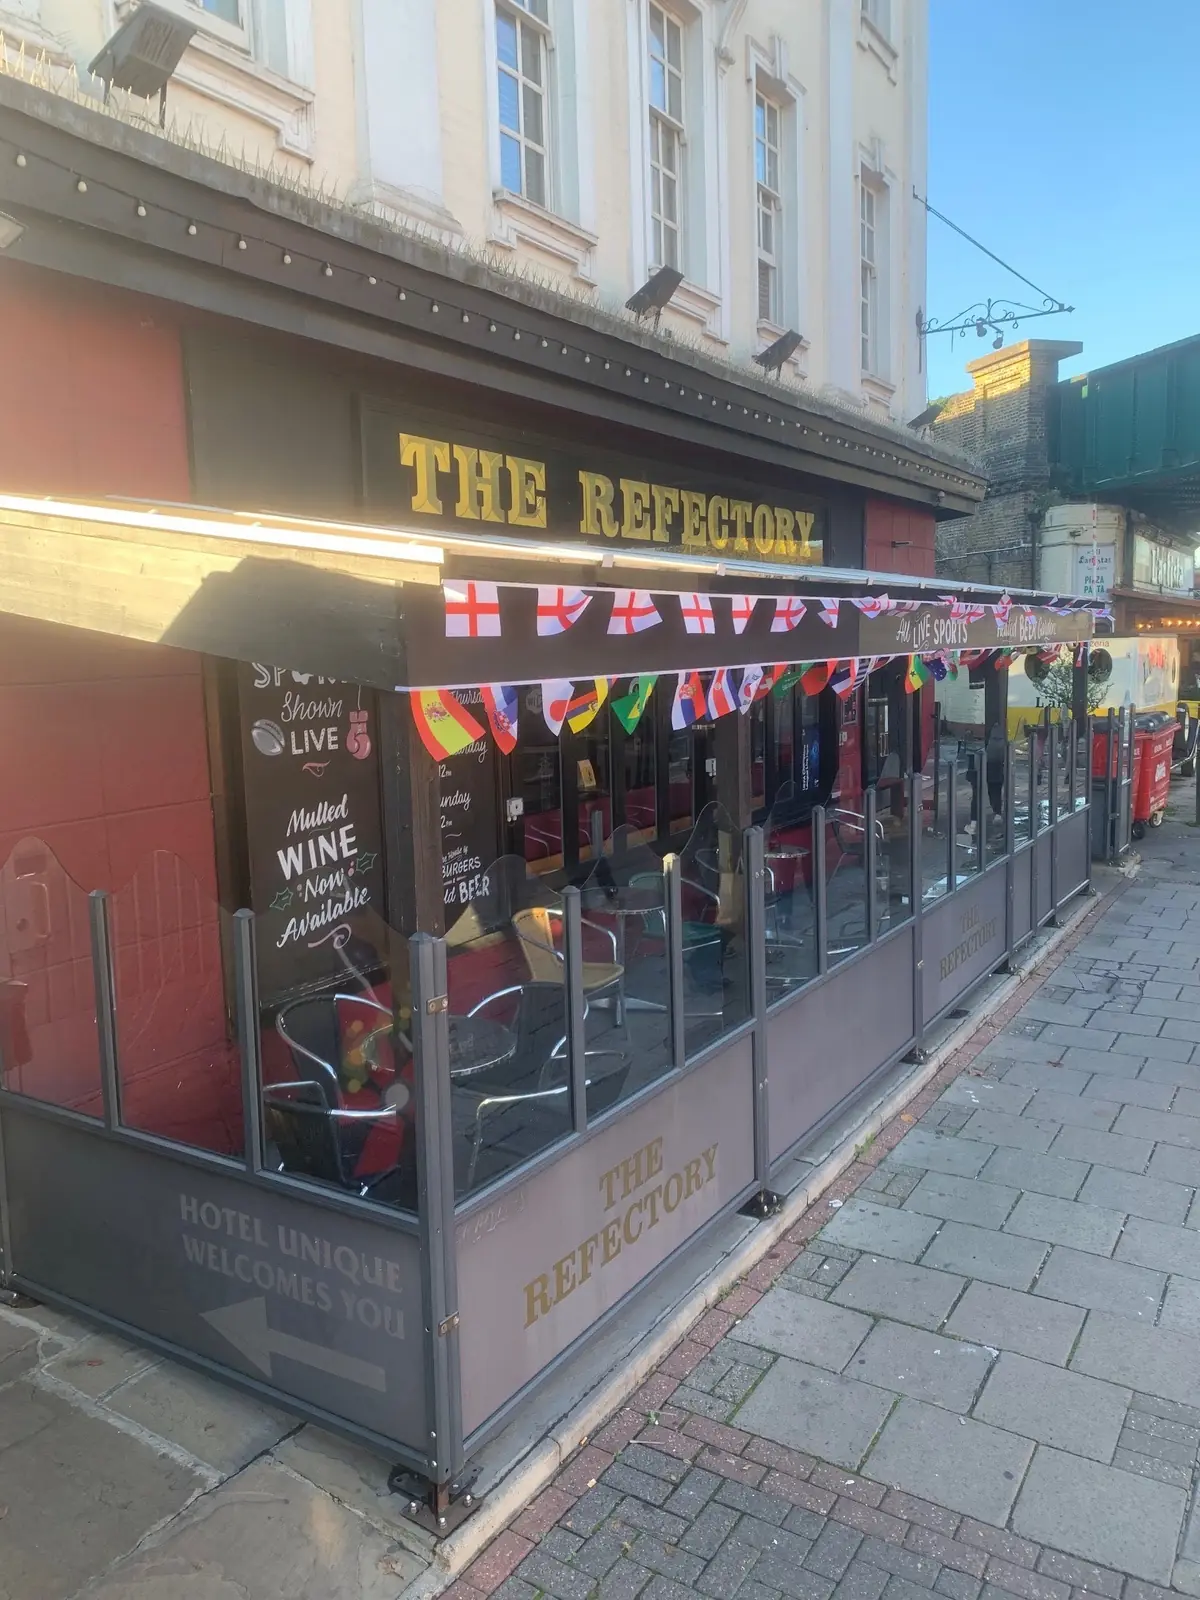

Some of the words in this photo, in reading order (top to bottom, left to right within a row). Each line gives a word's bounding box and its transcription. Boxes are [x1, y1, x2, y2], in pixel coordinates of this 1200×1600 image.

[399, 432, 547, 528] THE
[579, 470, 816, 558] REFECTORY
[1083, 586, 1105, 594] PATA
[913, 614, 931, 649] LIVE
[933, 619, 968, 645] SPORTS
[281, 691, 343, 722] Shown
[290, 727, 339, 755] LIVE
[286, 794, 349, 836] Mulled
[440, 790, 471, 810] unday
[277, 824, 358, 880] WINE
[304, 868, 345, 902] Now
[443, 886, 457, 904] ld
[459, 874, 490, 903] BEER
[276, 888, 371, 948] Available
[599, 1136, 664, 1212] THE
[179, 1194, 269, 1247] HOTEL
[277, 1225, 404, 1293] UNIQUE
[523, 1142, 719, 1330] REFECTORY
[182, 1234, 333, 1312] WELCOMES
[340, 1289, 405, 1340] YOU
